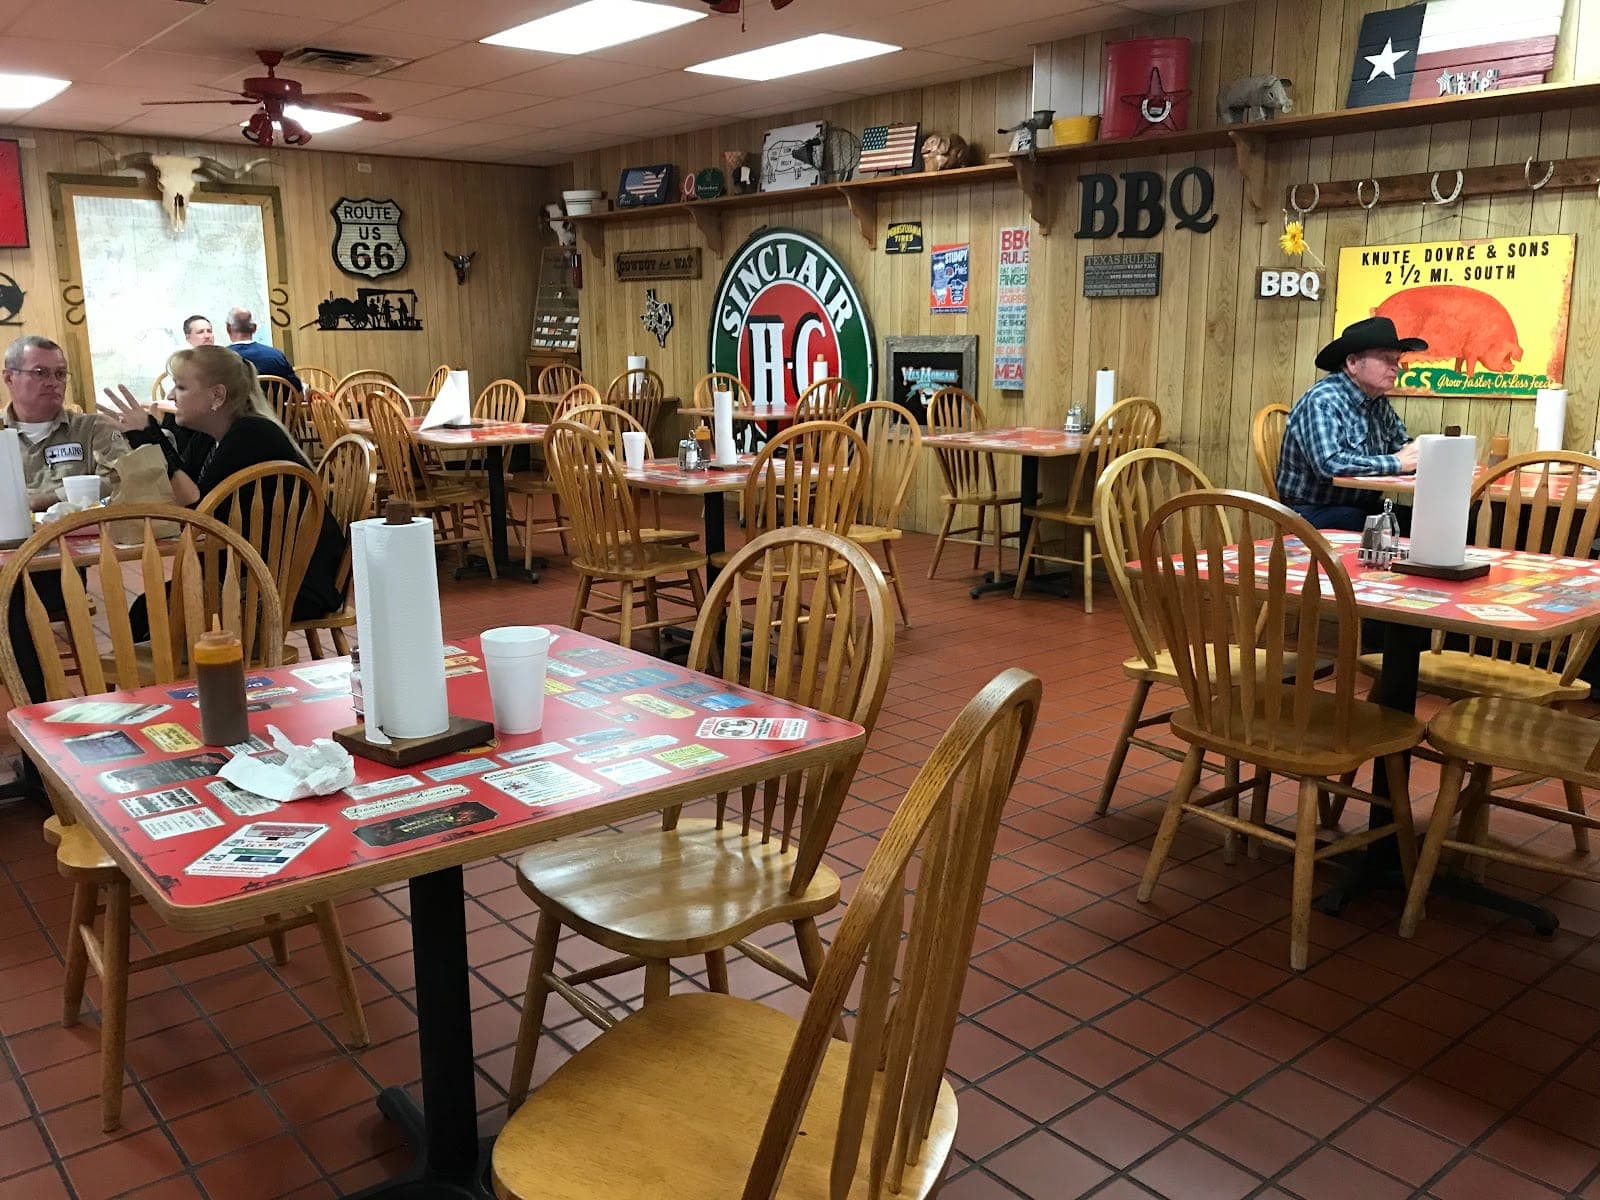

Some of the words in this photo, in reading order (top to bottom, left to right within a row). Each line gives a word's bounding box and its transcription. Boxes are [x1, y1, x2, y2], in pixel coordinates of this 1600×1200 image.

[1074, 166, 1219, 239] BBQ
[344, 205, 393, 219] ROUTE
[359, 226, 381, 240] US
[350, 242, 394, 270] 66
[944, 250, 968, 264] STUMPY
[1001, 251, 1028, 265] RULE
[1086, 255, 1121, 266] TEXAS
[1122, 253, 1157, 264] RULES
[1362, 249, 1411, 265] KNUTE
[1425, 246, 1475, 262] DOVRE
[1487, 244, 1497, 258] &
[1508, 241, 1550, 257] SONS
[620, 259, 656, 272] COWBOY
[1385, 271, 1392, 284] 2
[1430, 268, 1453, 282] MI.
[1464, 265, 1516, 280] SOUTH
[722, 244, 853, 338] SINCLAIR
[1261, 271, 1320, 300] BBQ
[995, 363, 1024, 379] MEA
[1437, 373, 1462, 389] Grow
